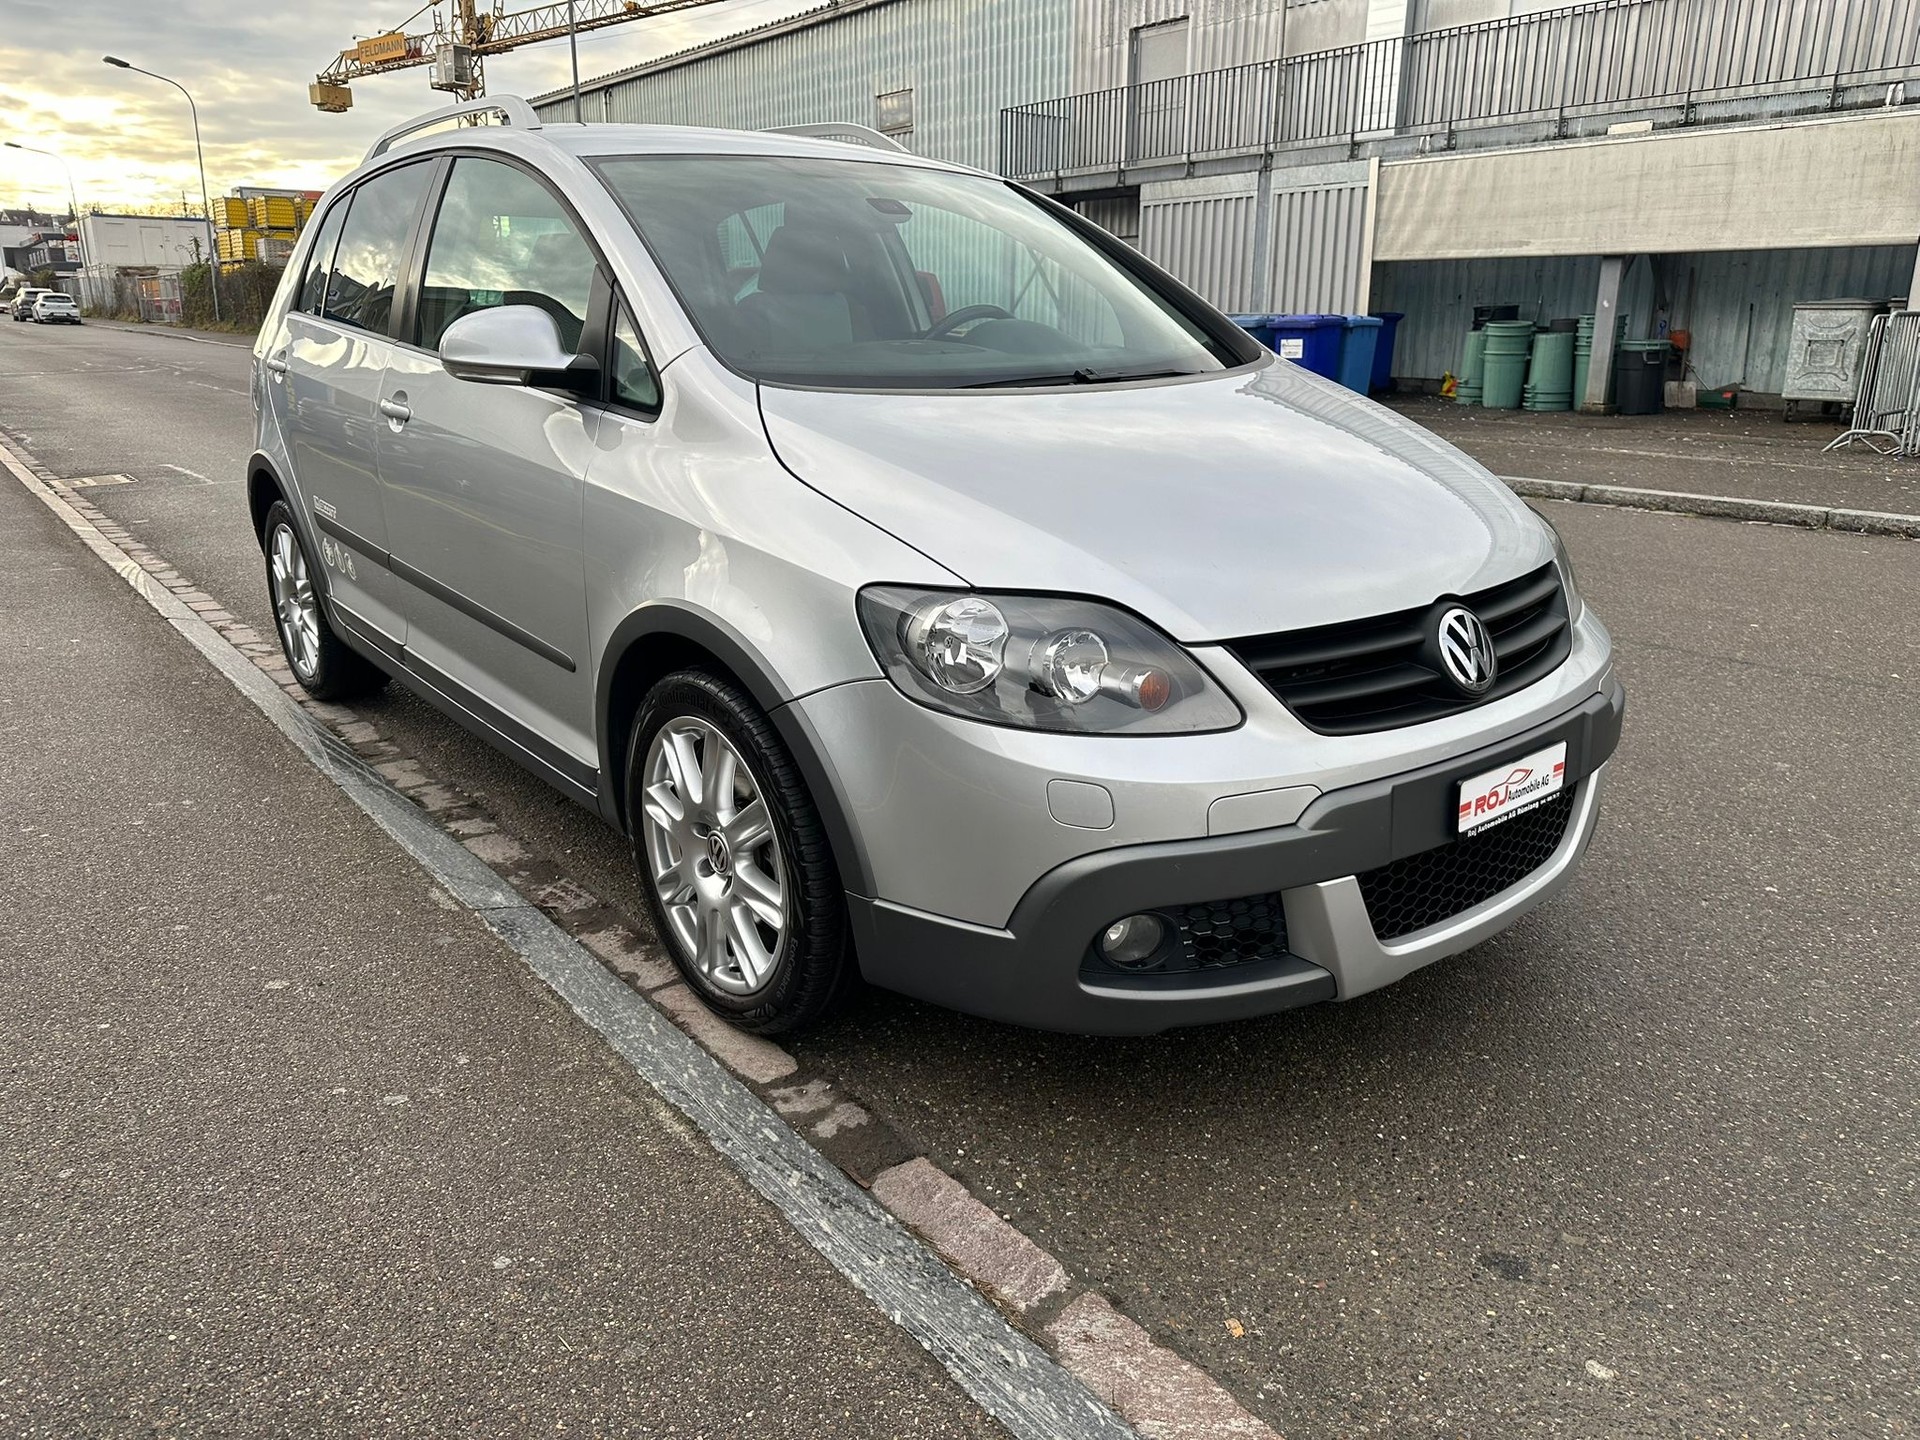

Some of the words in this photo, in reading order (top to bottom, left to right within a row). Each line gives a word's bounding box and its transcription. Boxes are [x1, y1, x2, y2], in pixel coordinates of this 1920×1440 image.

[360, 39, 403, 57] FELDMANN
[1439, 608, 1495, 690] VW
[1474, 785, 1509, 816] ROJ
[1508, 779, 1541, 802] Automobile
[1541, 774, 1550, 790] AG
[1467, 828, 1477, 838] Roj
[1478, 814, 1508, 833] Automobile
[1508, 810, 1516, 820] AG
